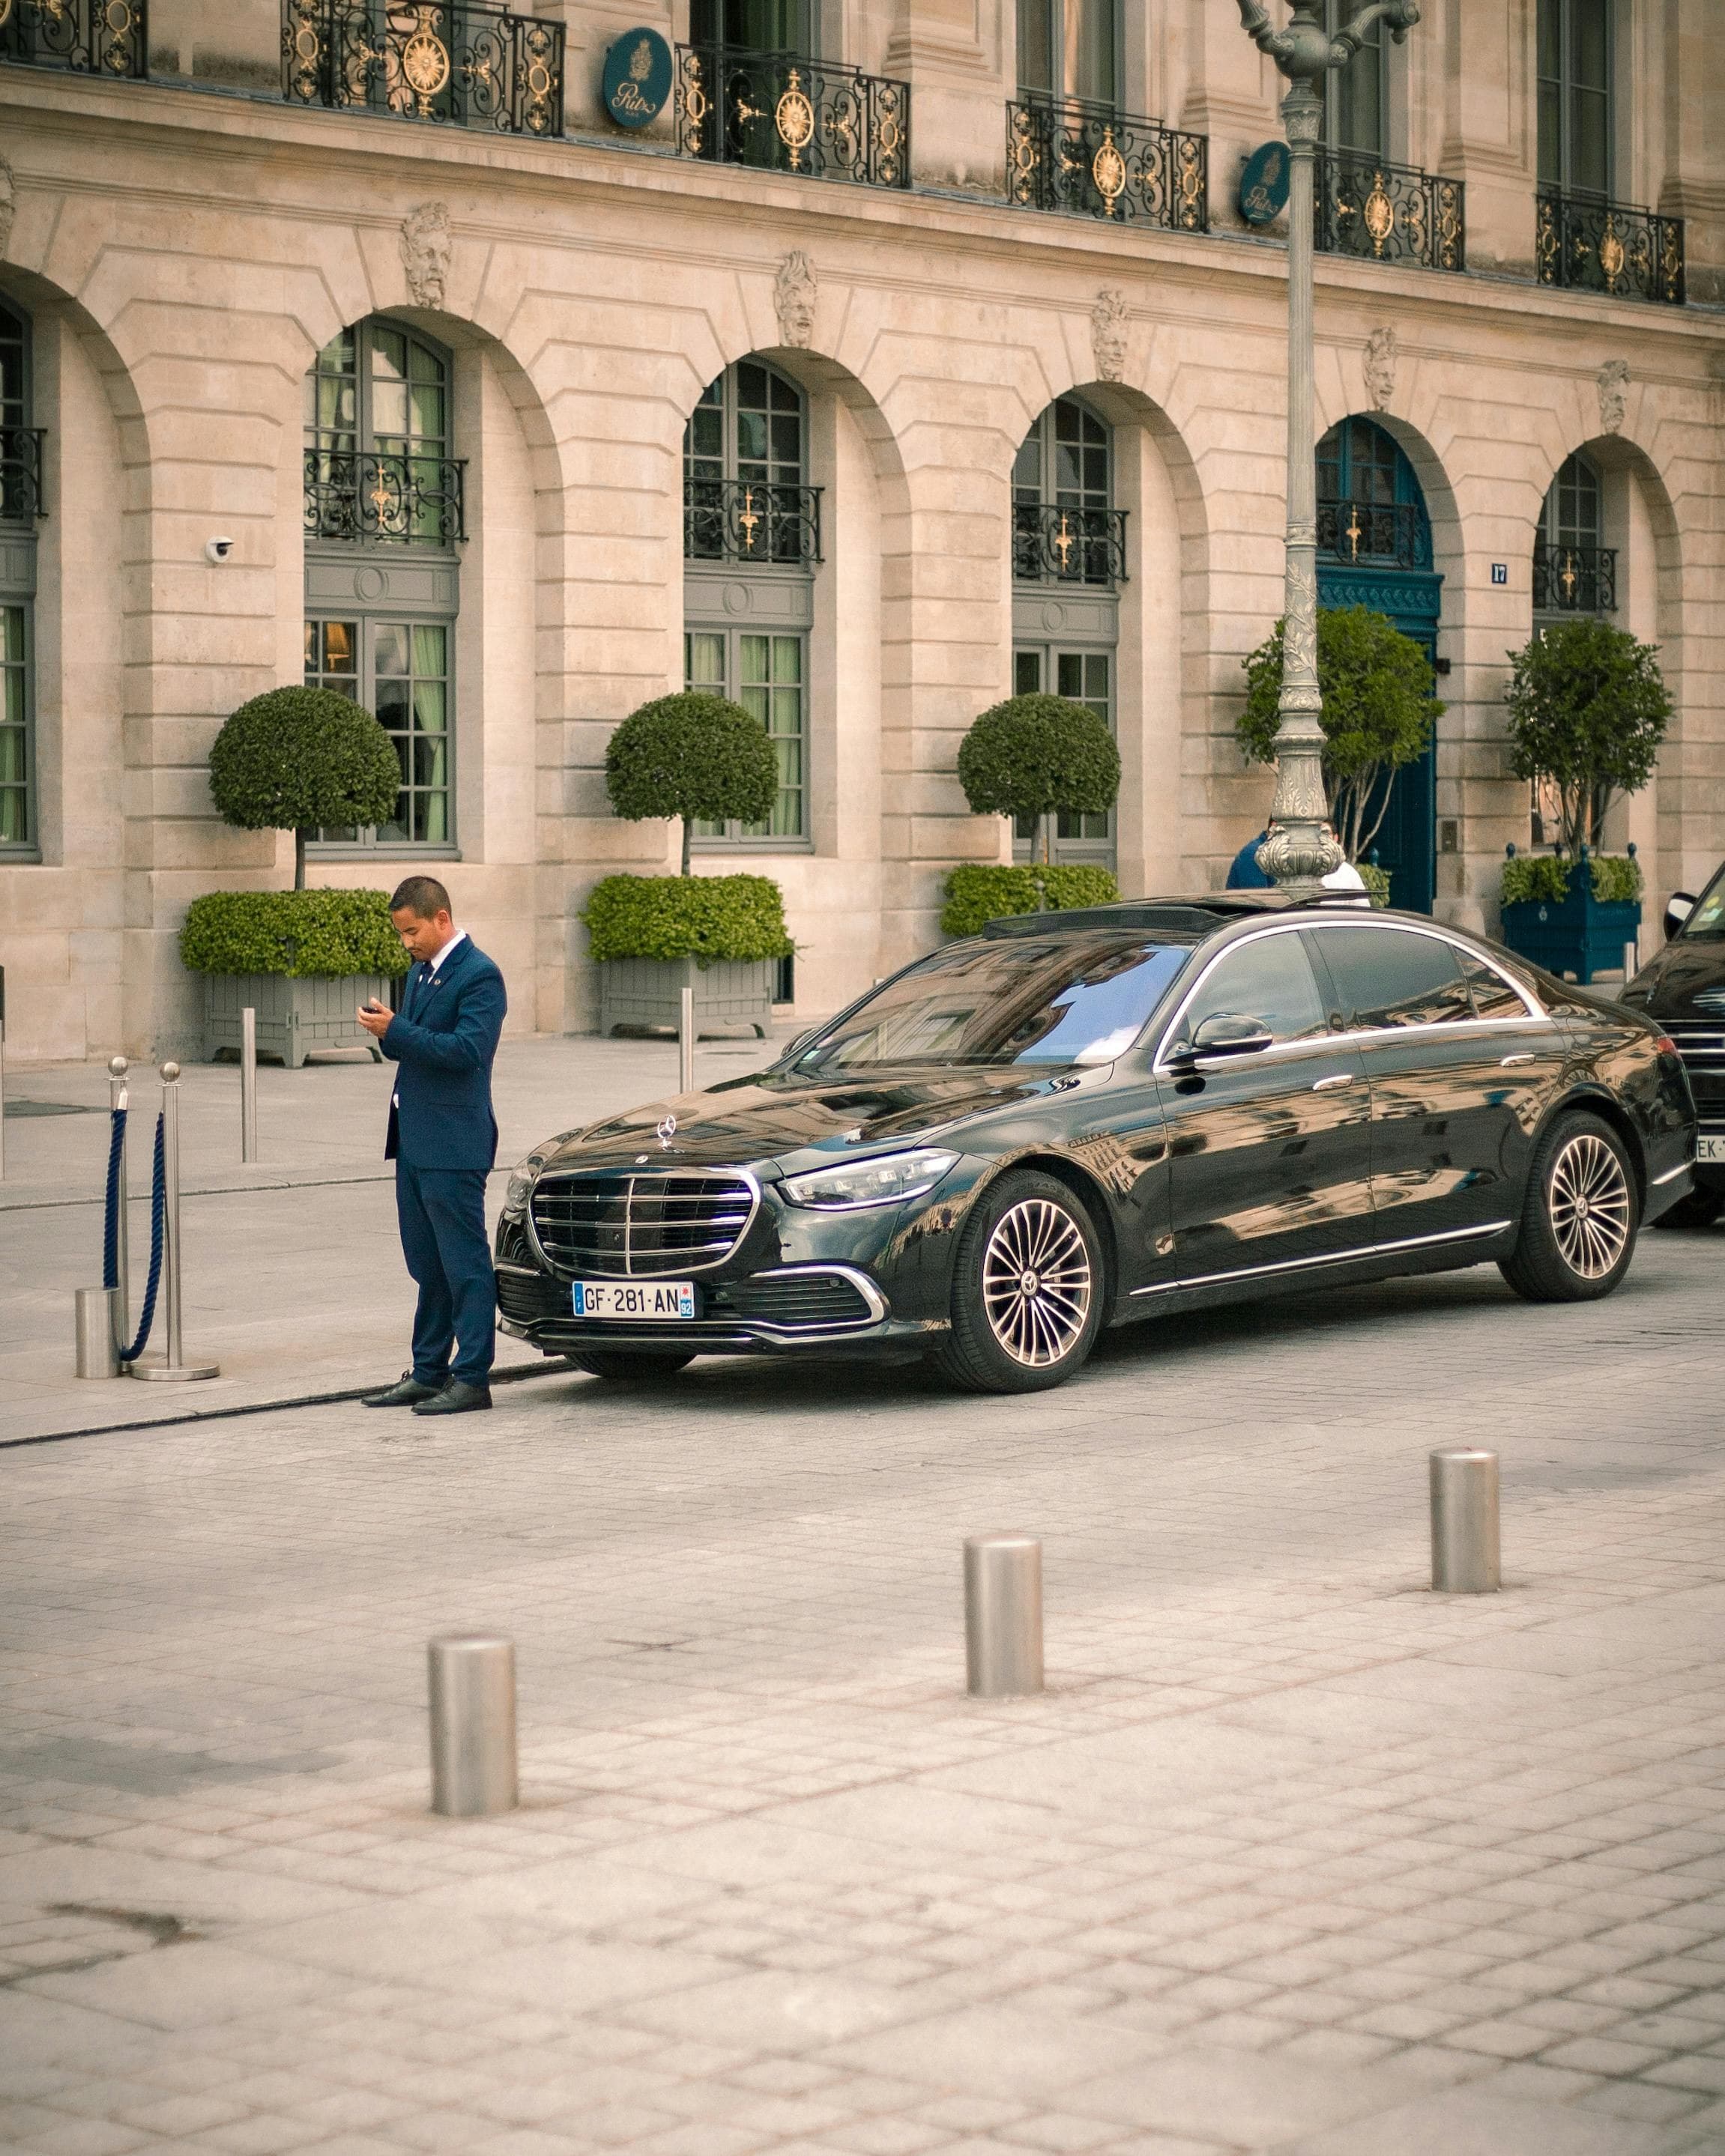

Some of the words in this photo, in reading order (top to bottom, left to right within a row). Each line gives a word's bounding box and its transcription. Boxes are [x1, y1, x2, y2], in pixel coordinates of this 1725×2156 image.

[611, 82, 656, 114] Ritz
[1494, 565, 1505, 582] 17
[1697, 1139, 1725, 1158] EK-
[584, 1287, 679, 1312] GF-281-AN
[680, 1303, 692, 1315] 92
